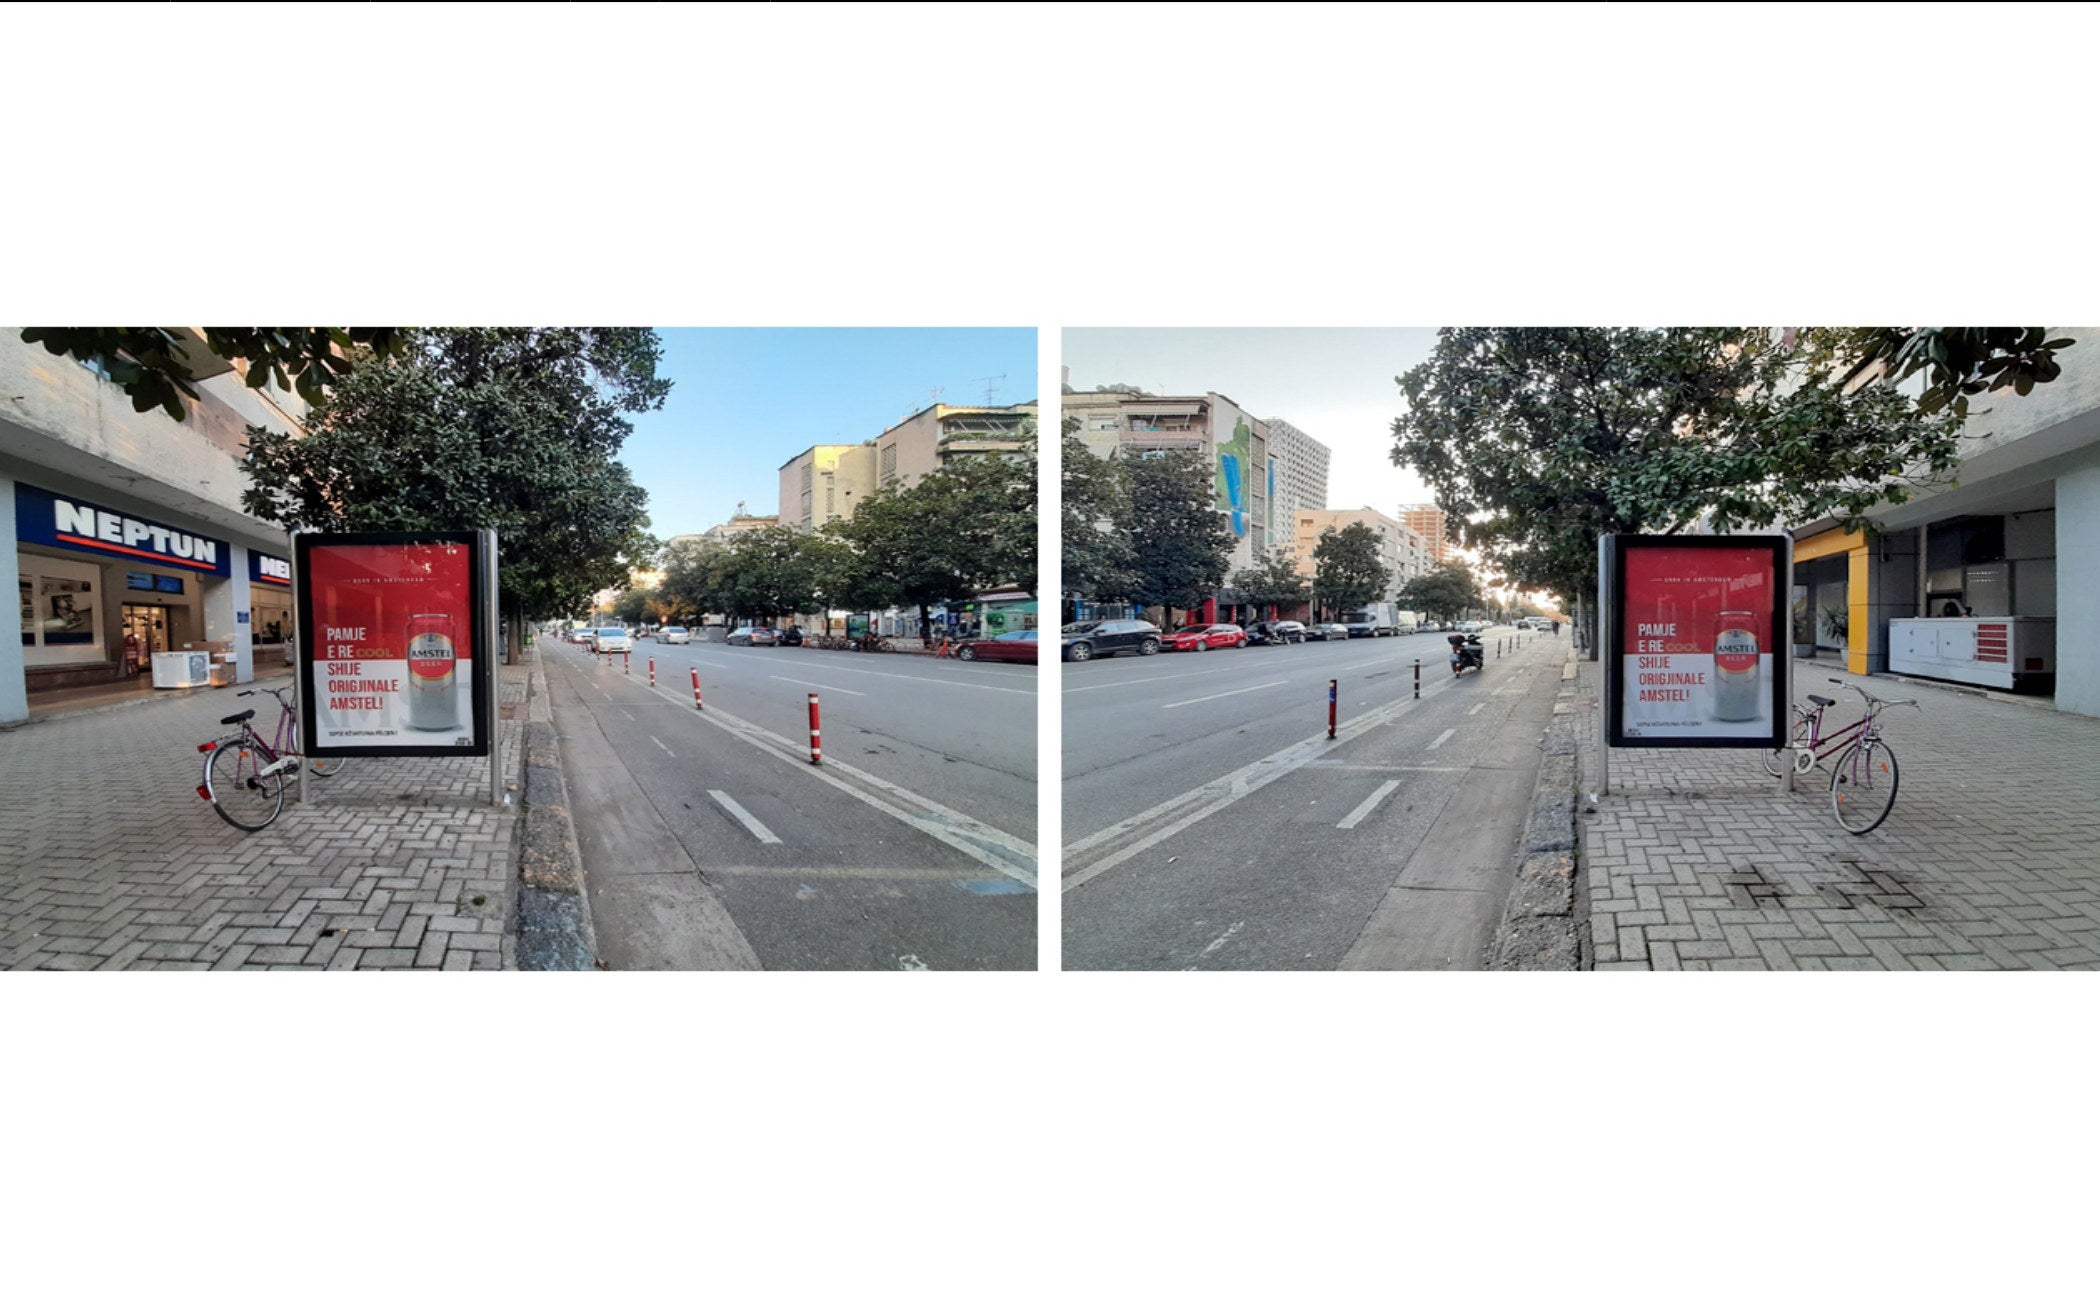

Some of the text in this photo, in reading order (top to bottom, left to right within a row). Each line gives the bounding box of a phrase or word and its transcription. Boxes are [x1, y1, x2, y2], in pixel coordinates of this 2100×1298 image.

[54, 500, 217, 564] NEPTUN
[326, 627, 367, 641] PAMJE
[1638, 623, 1677, 637] PAMJE
[327, 645, 394, 659] E RE COOL
[1638, 640, 1700, 652] E RE COOL
[327, 662, 361, 676] SHIJE
[1638, 656, 1670, 669] SHIJE
[1639, 672, 1706, 685] ORIGJINALE
[328, 679, 399, 693] ORIGJINALE
[1639, 689, 1690, 702] AMSTEL!
[330, 697, 384, 710] AMSTEL!
